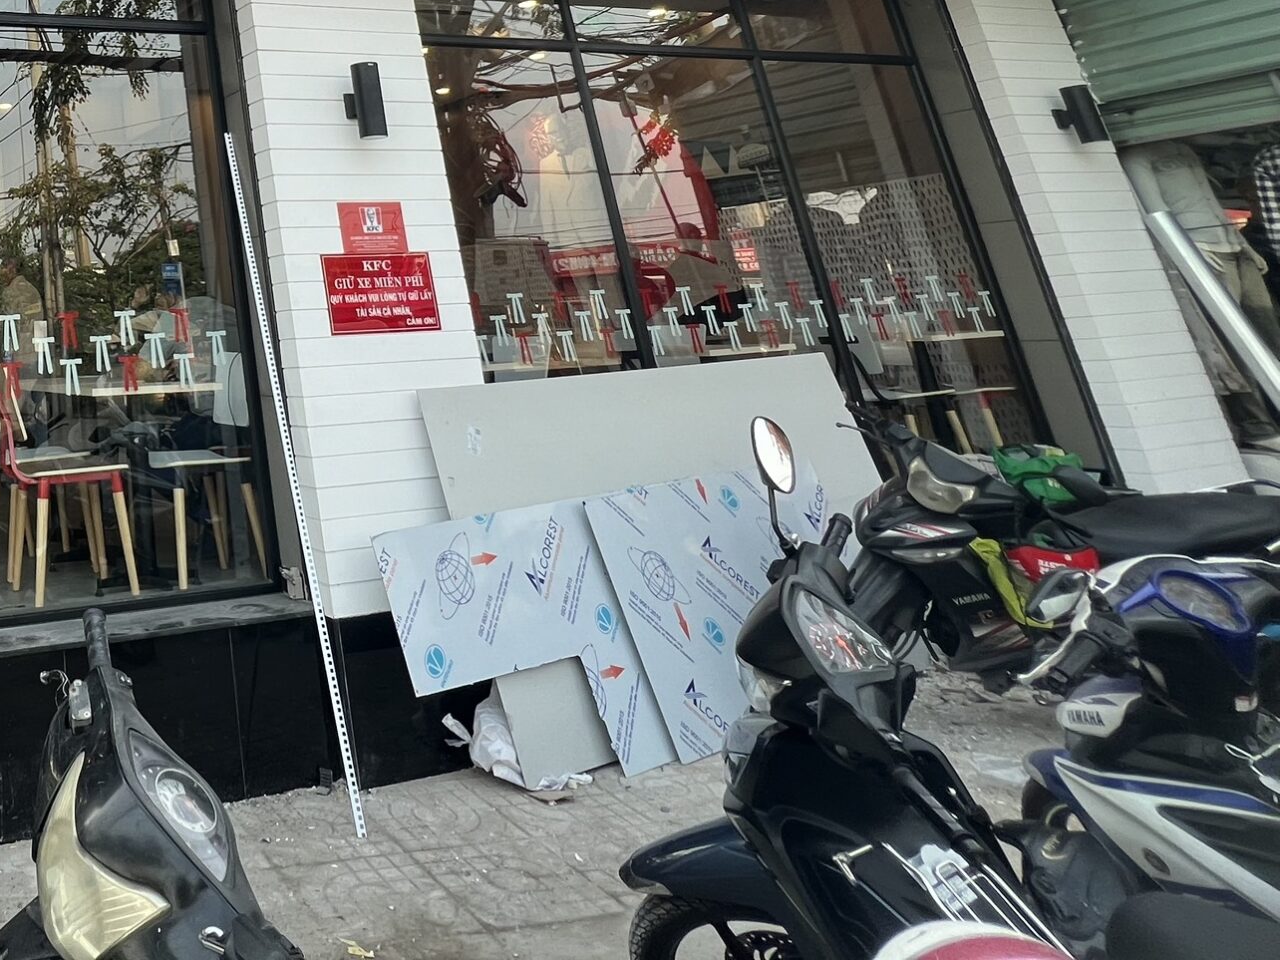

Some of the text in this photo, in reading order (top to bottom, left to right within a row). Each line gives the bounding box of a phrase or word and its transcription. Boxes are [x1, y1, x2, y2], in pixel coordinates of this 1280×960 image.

[363, 259, 392, 271] KFC
[334, 275, 355, 290] GIỮ
[356, 277, 372, 289] XE
[405, 271, 424, 287] PHÍ
[344, 291, 368, 304] KHÁCH
[356, 305, 368, 318] TÀI
[382, 305, 392, 317] CÁ
[523, 515, 560, 597] ALCOREST
[700, 535, 761, 601] ALCOREST
[951, 591, 991, 606] YAMAHA
[1066, 710, 1106, 728] YAMAHA
